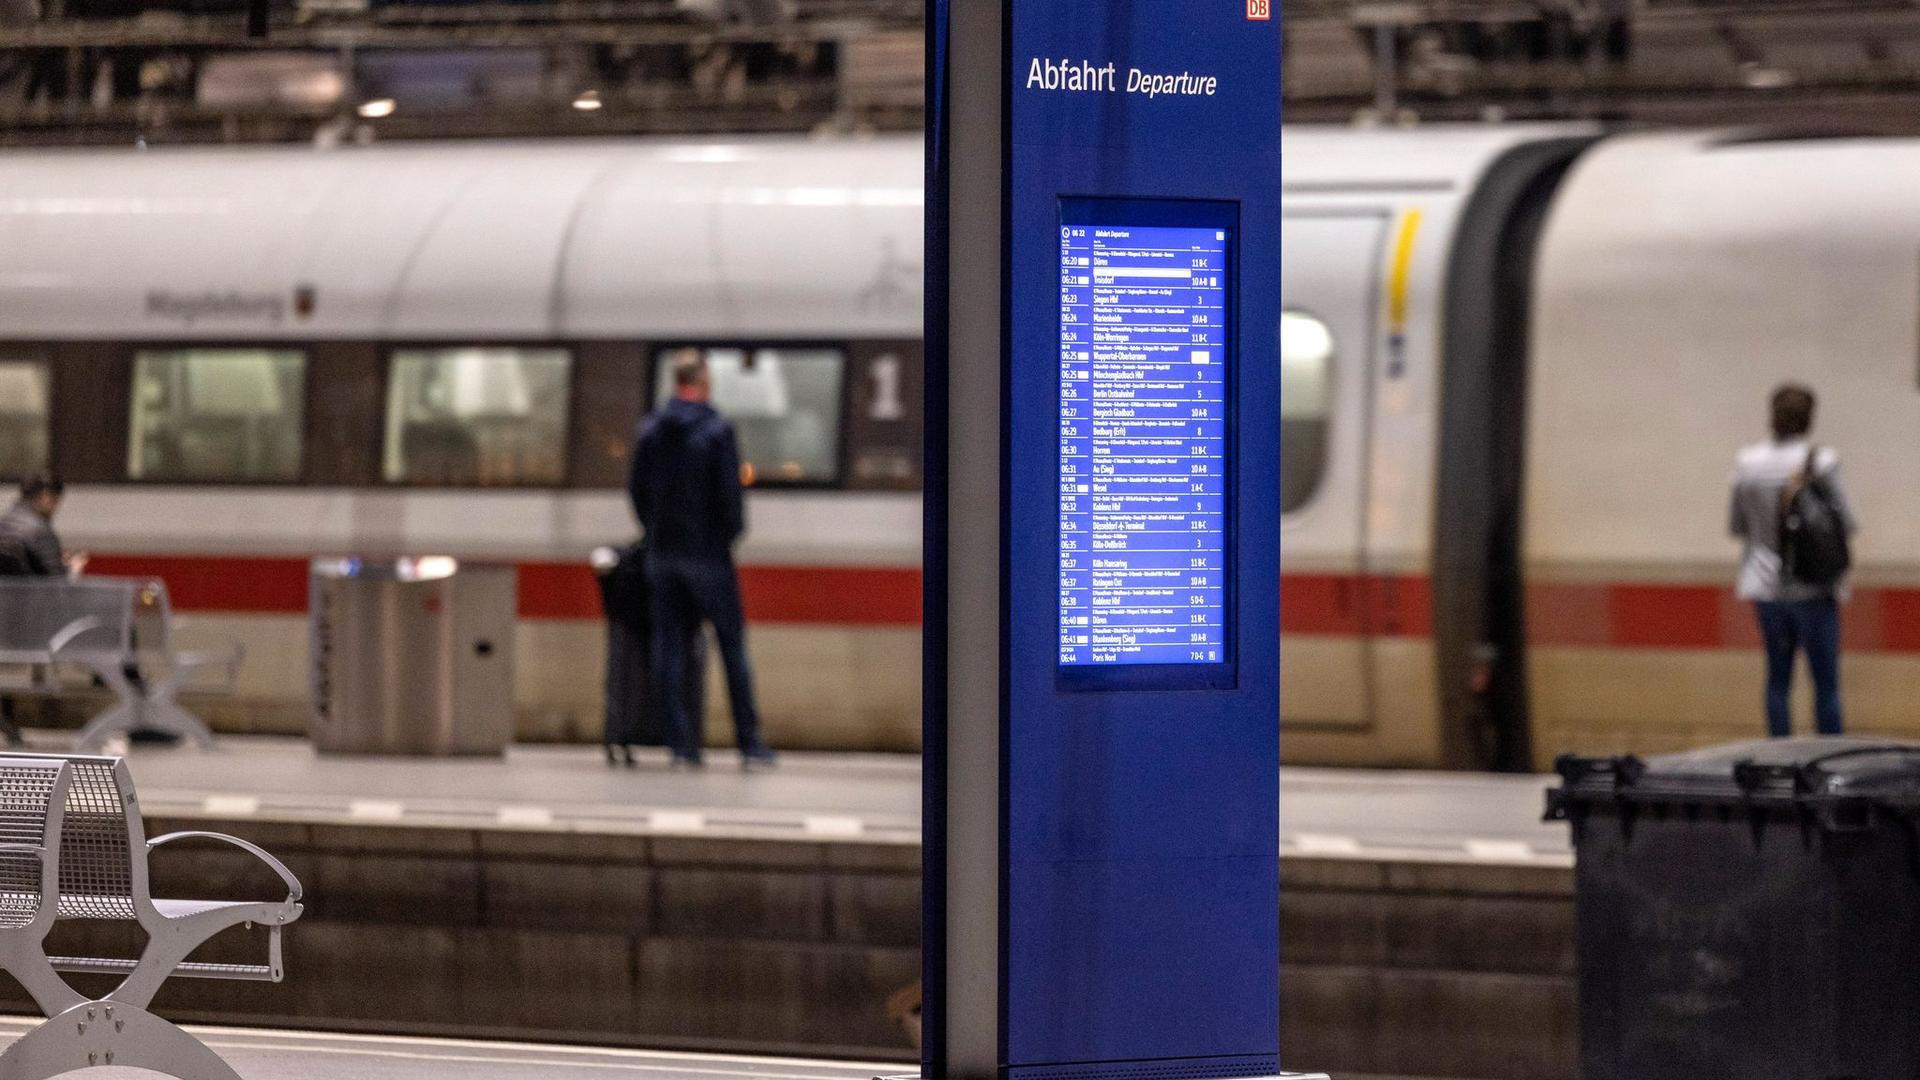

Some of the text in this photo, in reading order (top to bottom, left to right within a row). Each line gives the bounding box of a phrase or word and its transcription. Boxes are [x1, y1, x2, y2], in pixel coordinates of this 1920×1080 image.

[1249, 0, 1267, 16] DB
[1027, 57, 1217, 98] Abfahrt Departure
[1062, 257, 1077, 265] 06:20
[1062, 276, 1077, 284] 06:21
[1062, 295, 1077, 303] 06:23
[1062, 314, 1077, 322] 06:24
[1062, 333, 1077, 341] 06:24
[1062, 351, 1077, 359] 06:25
[1062, 370, 1077, 378] 06:25
[872, 356, 904, 418] 1
[1062, 389, 1077, 397] 06:26
[1093, 390, 1134, 398] Berlin Ostbahnhof
[1062, 408, 1077, 416] 06:27
[1093, 409, 1135, 419] Bergisch Gladbach
[1062, 427, 1077, 435] 06:29
[1061, 446, 1077, 454] 06:30
[1061, 465, 1077, 473] 06:31
[1061, 484, 1076, 492] 06:31
[1093, 484, 1107, 492] Wesel
[1061, 503, 1076, 511] 06:32
[1061, 522, 1076, 530] 06:34
[1093, 522, 1145, 530] Düsseldorf Terminal
[1061, 541, 1076, 549] 06:35
[1061, 559, 1076, 567] 06:37
[1061, 578, 1076, 586] 06:37
[1061, 597, 1076, 605] 06:38
[1093, 597, 1111, 605] Koblenz
[1061, 616, 1076, 624] 06:40
[1061, 635, 1076, 643] 06:41
[1061, 655, 1076, 663] 06:44
[1093, 654, 1116, 662] Paris Nord
